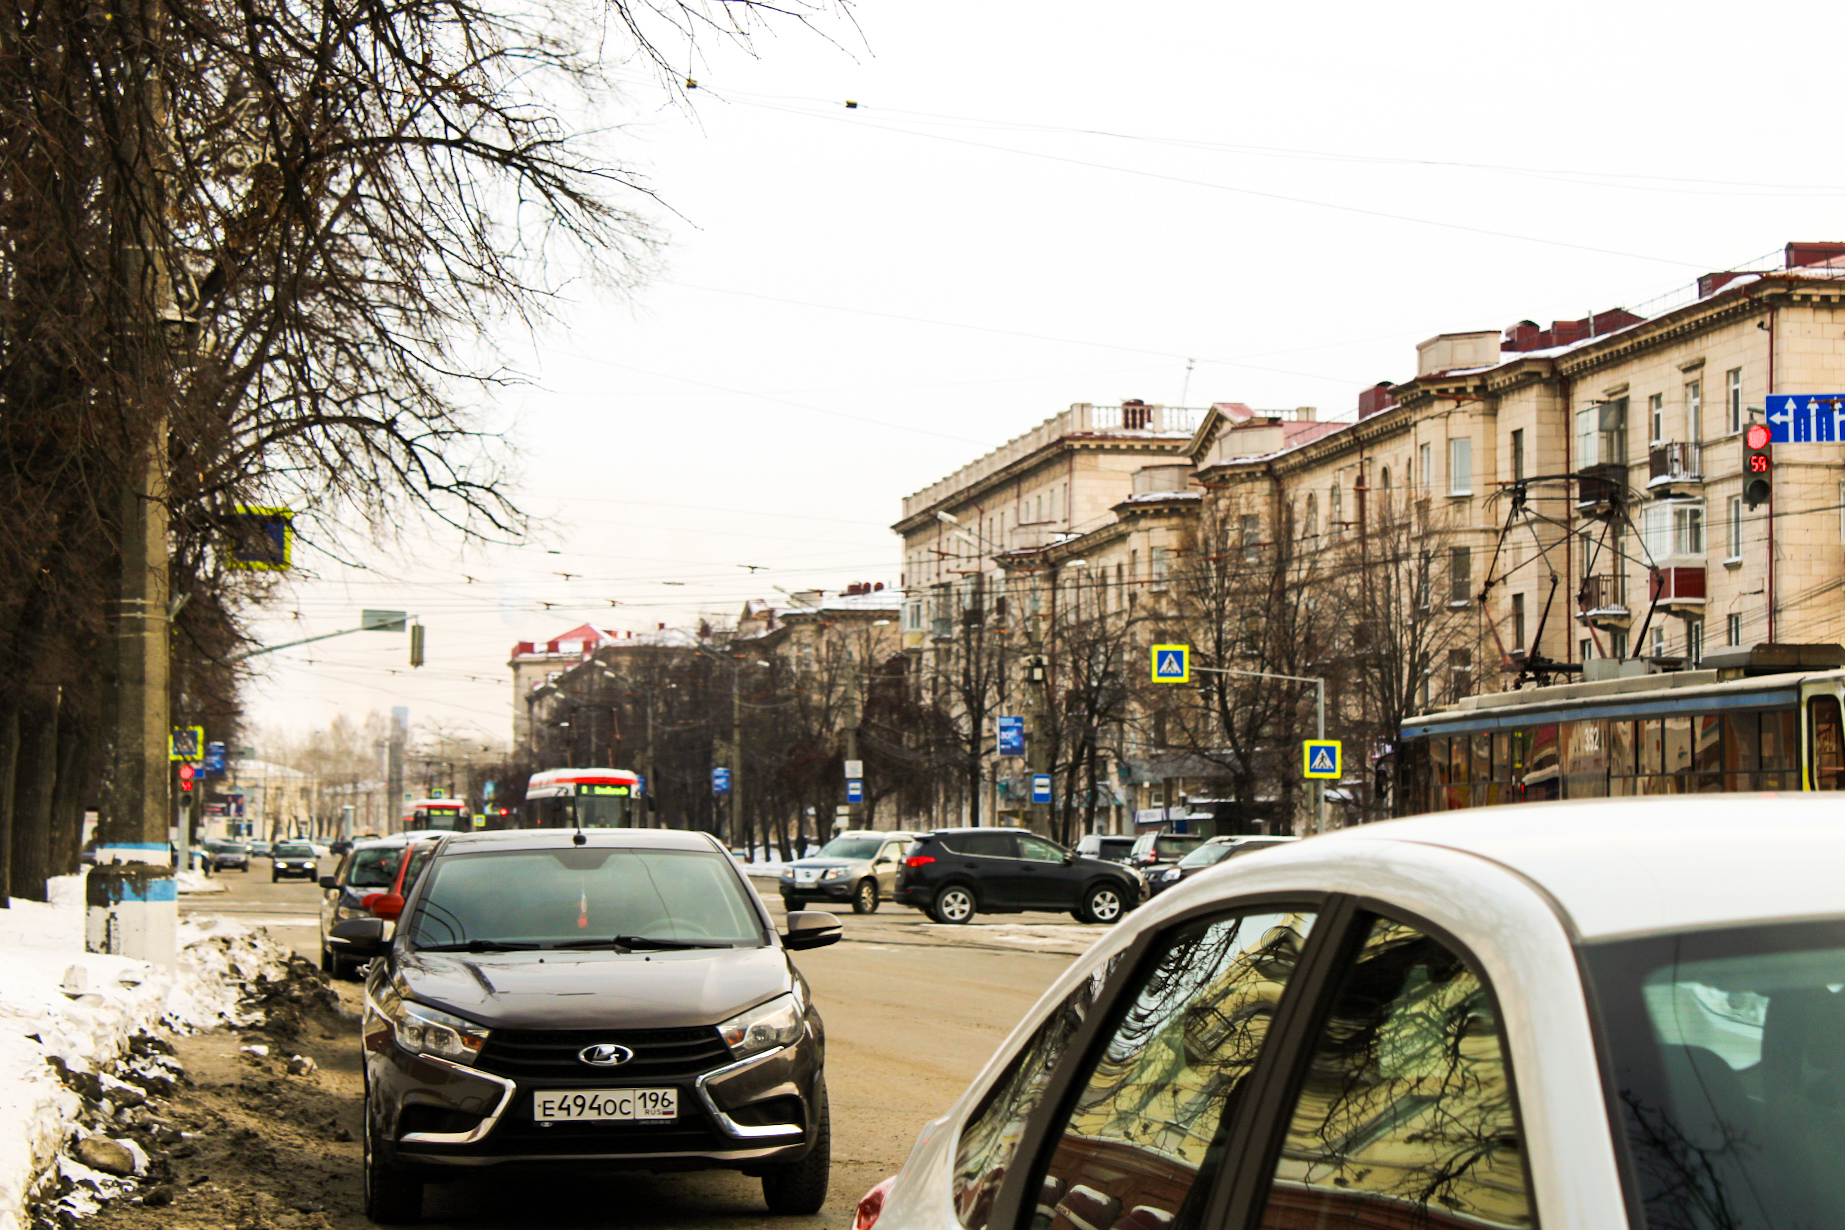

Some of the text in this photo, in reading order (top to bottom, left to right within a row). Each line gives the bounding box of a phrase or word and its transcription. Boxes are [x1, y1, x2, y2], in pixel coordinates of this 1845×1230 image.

[1751, 456, 1767, 472] 59
[1585, 727, 1599, 752] 352
[638, 1091, 671, 1109] 196
[644, 1108, 662, 1116] RUS
